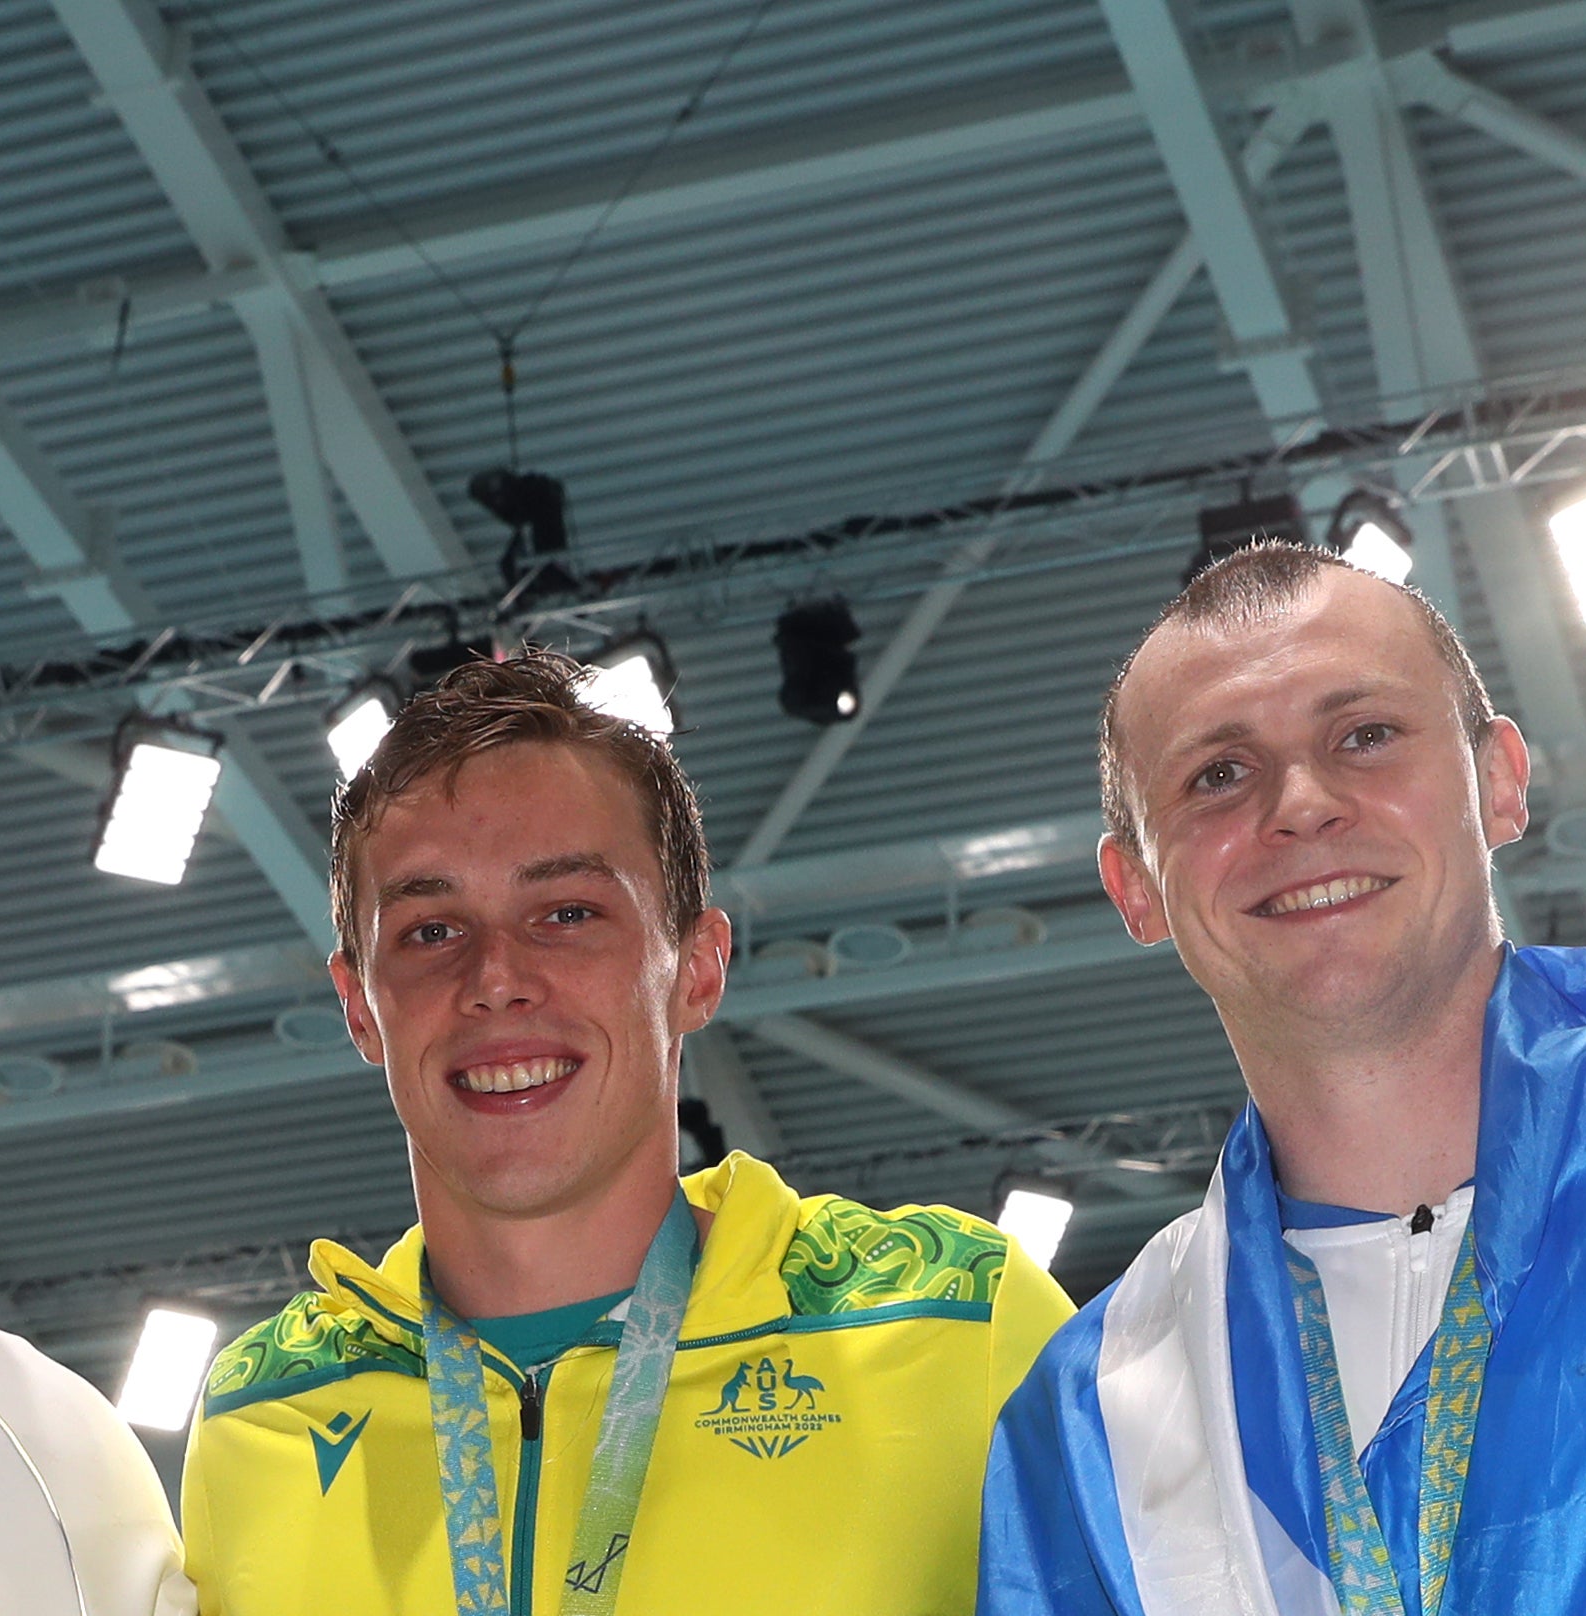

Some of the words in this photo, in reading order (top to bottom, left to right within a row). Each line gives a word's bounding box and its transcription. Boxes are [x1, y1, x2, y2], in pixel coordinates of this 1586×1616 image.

[694, 1414, 799, 1429] COMMONWEALTH
[801, 1413, 842, 1423] GAMES
[714, 1423, 791, 1435] BIRMINGHAM
[794, 1423, 823, 1431] 2022
